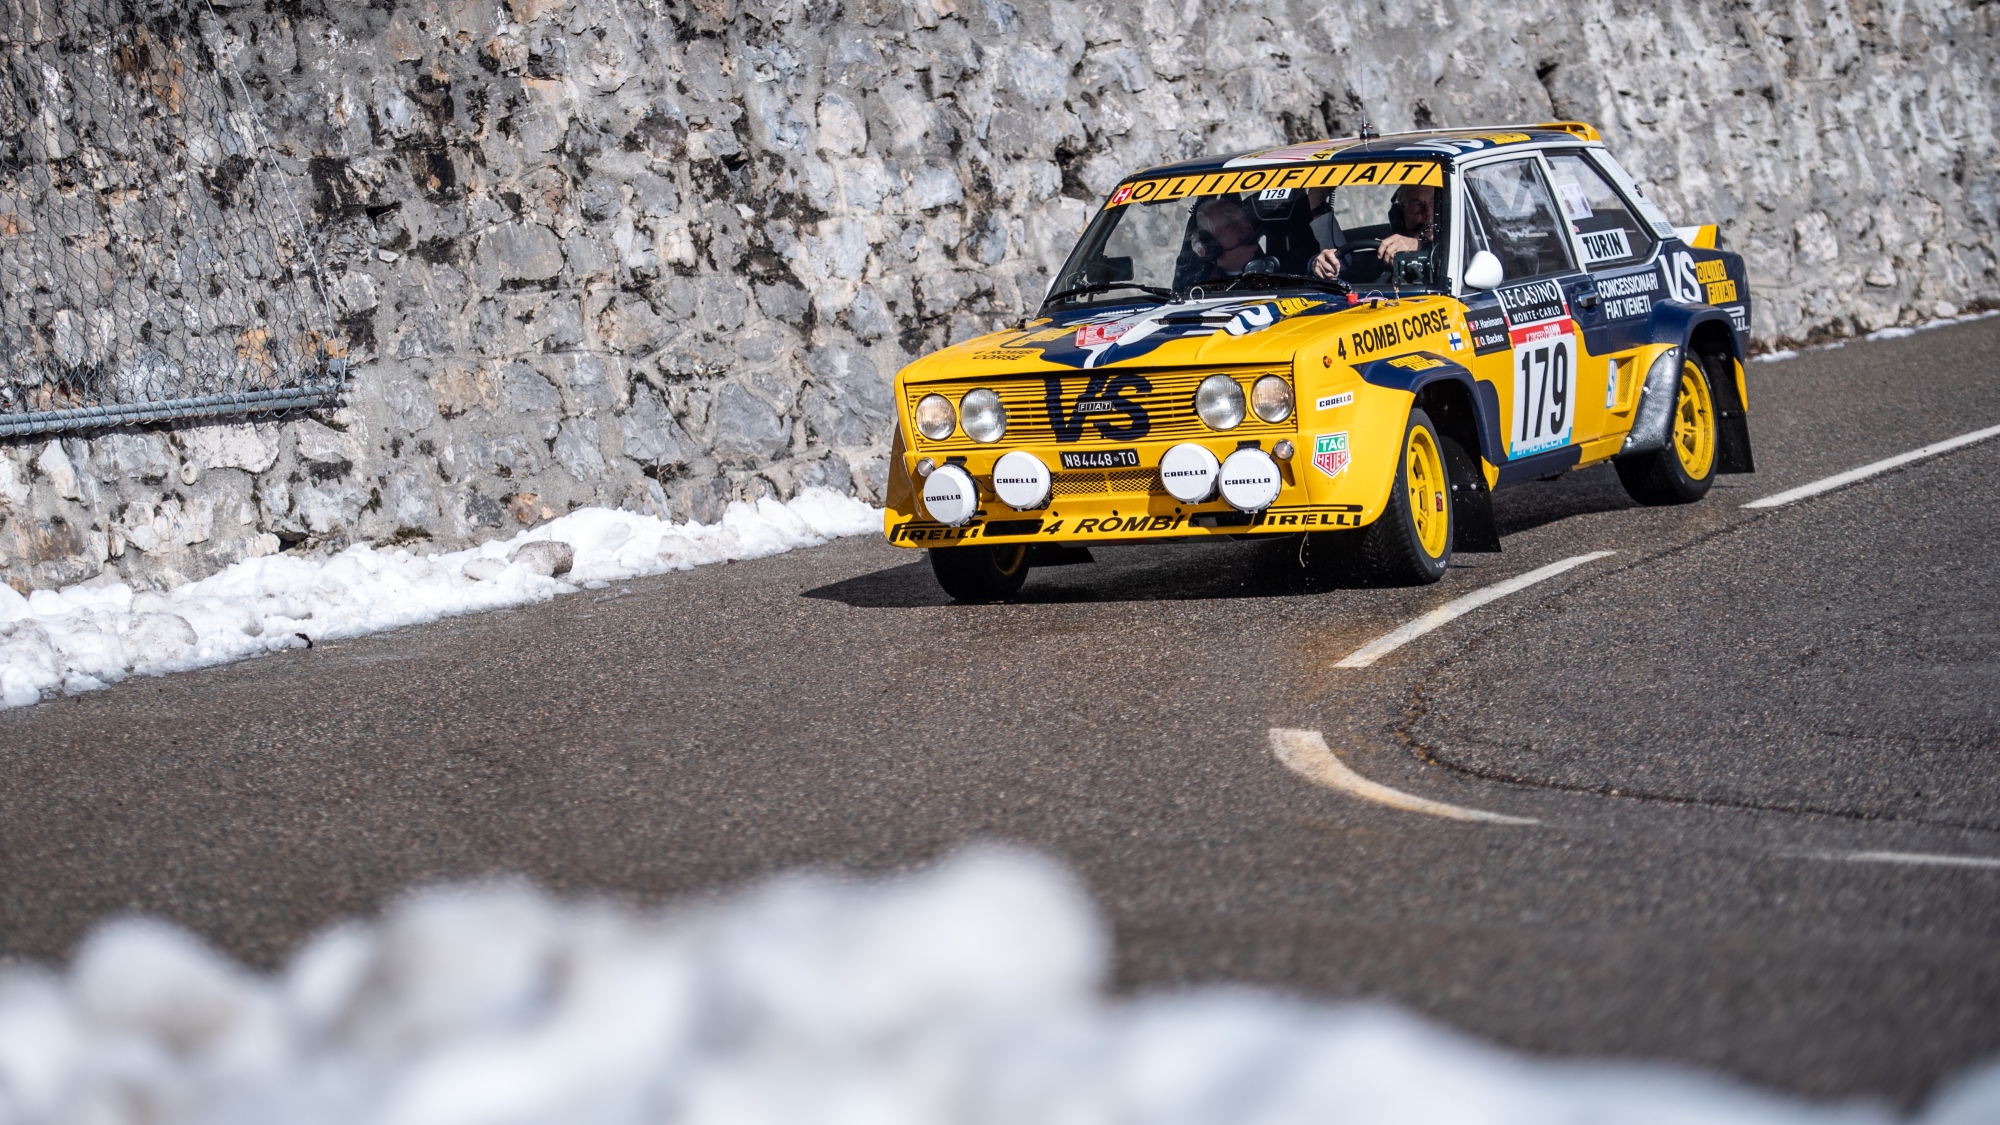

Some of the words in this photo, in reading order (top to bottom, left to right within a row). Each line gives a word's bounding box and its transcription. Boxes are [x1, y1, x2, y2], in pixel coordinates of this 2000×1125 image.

[1265, 188, 1286, 199] 179
[1582, 232, 1624, 259] TURIN
[1658, 251, 1703, 303] VS
[1697, 262, 1726, 281] OLIO
[1500, 290, 1516, 309] LE
[1513, 281, 1558, 307] CASINO
[1597, 273, 1659, 299] CONCESSIONARI
[1709, 283, 1737, 302] FIAT
[1604, 299, 1623, 319] FIAT
[1624, 295, 1652, 316] VENETI
[1338, 337, 1347, 360] 4
[1352, 322, 1401, 356] ROMBI
[1402, 307, 1451, 341] CORSE
[1319, 394, 1352, 408] CARELLO
[1522, 342, 1568, 441] 179
[1043, 374, 1153, 443] VS
[1079, 401, 1111, 411] FIAT
[1320, 437, 1345, 451] TAG
[1064, 453, 1112, 467] N84448
[1317, 452, 1347, 472] HEUER
[1164, 469, 1207, 477] CARELLO
[1225, 477, 1271, 485] CARELLO
[925, 494, 961, 502] CARELLO
[1042, 519, 1065, 535] 4
[1072, 514, 1186, 534] ROMBI
[1252, 504, 1363, 527] PIRELLI
[889, 519, 983, 543] PIRELLI
